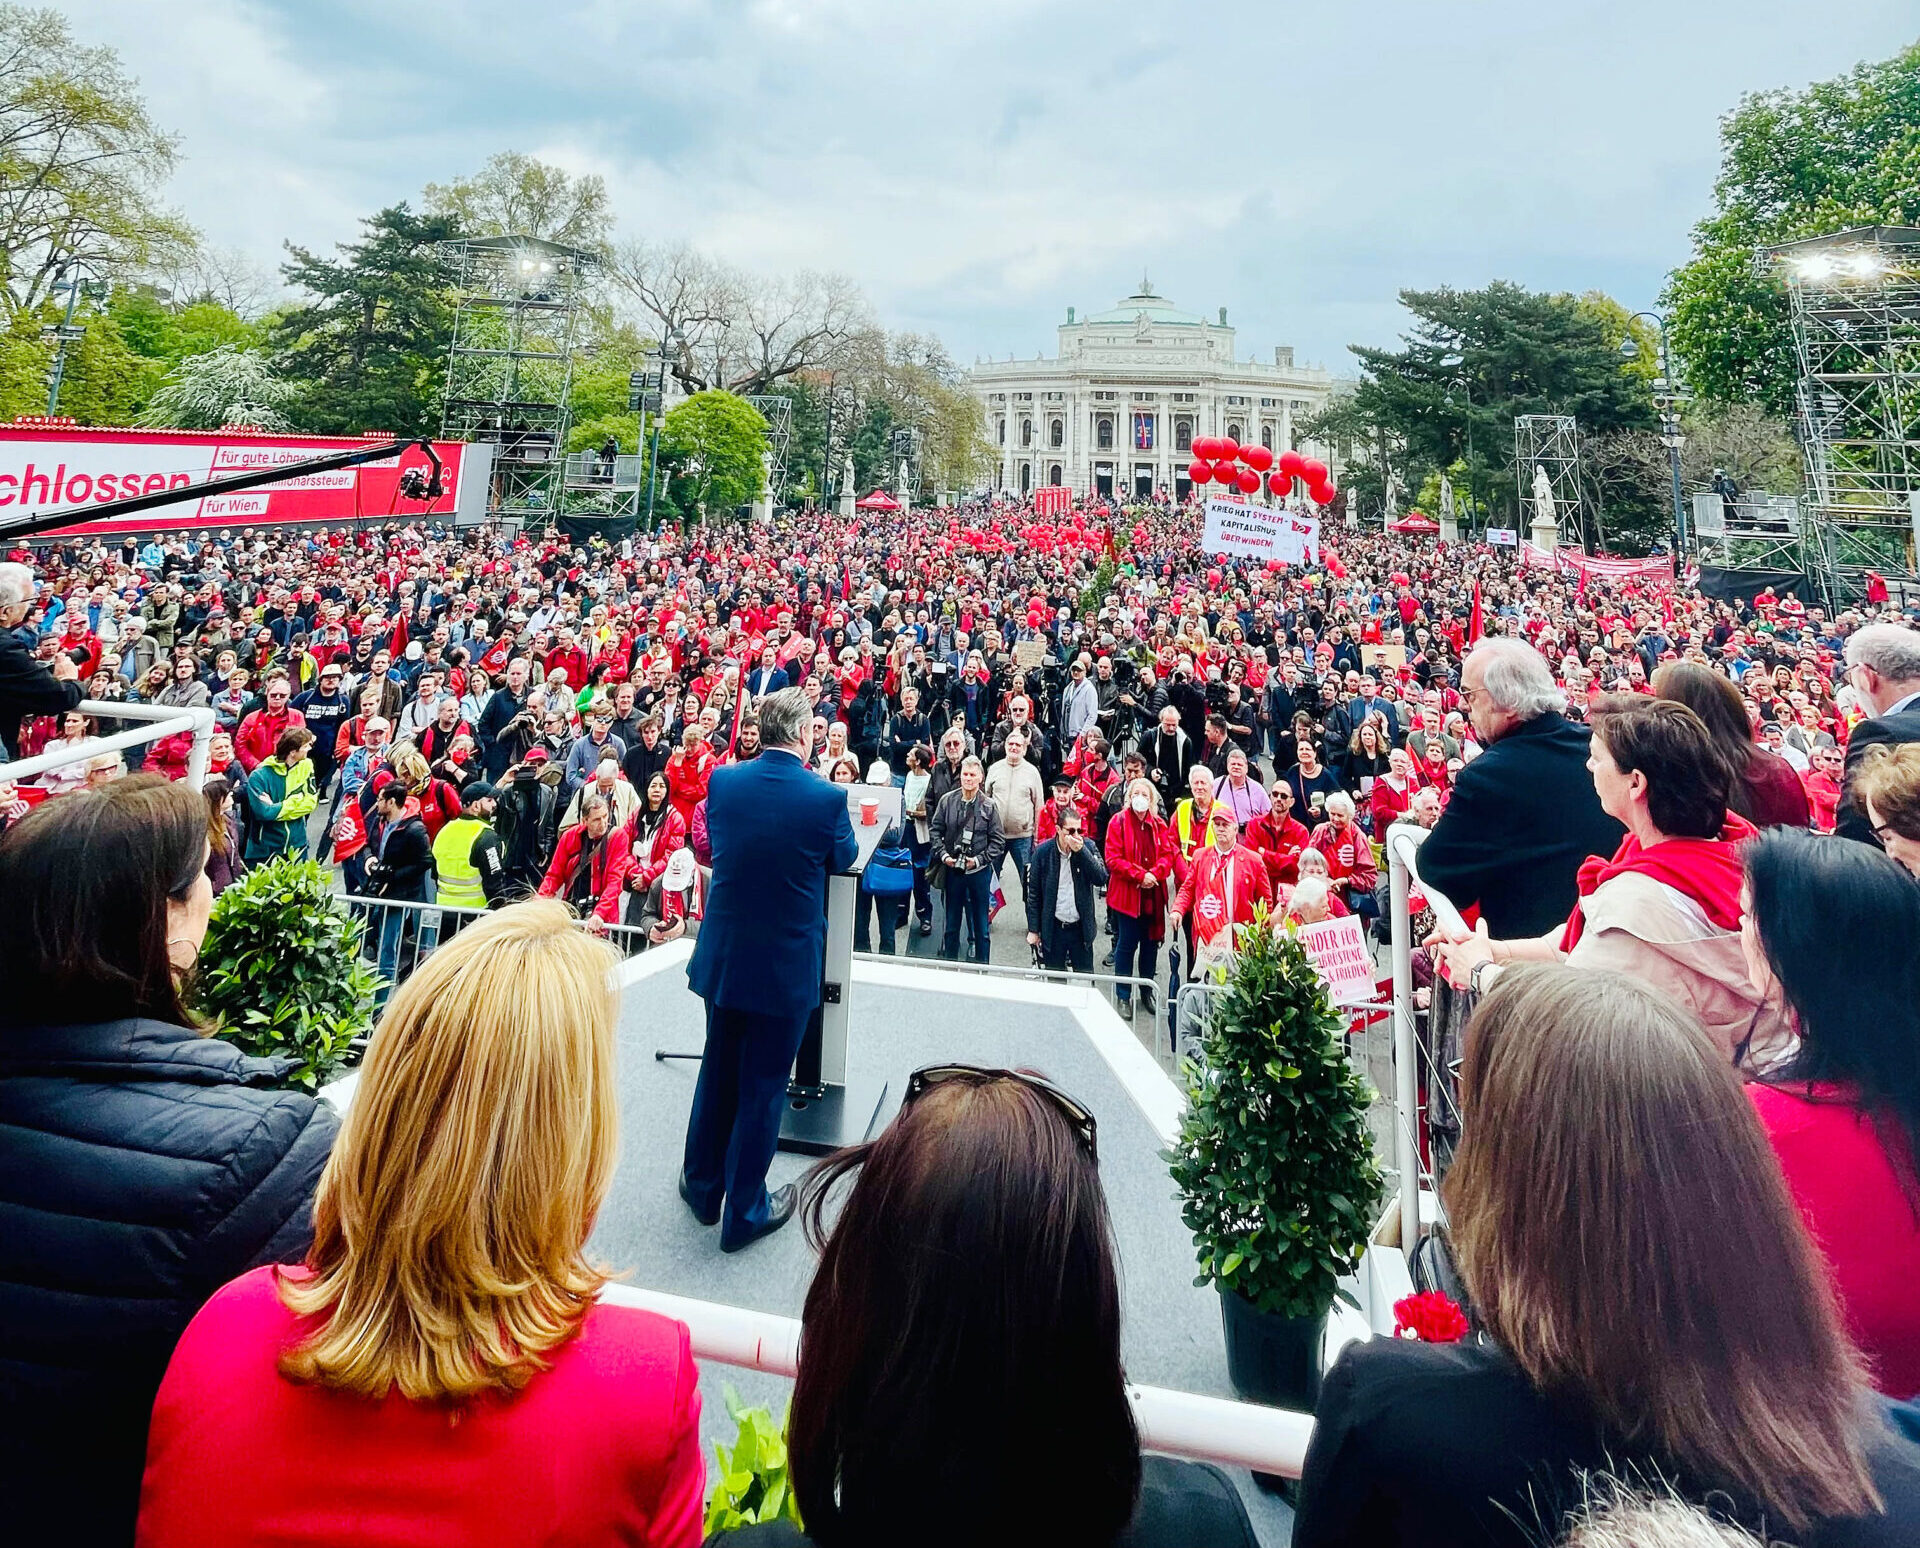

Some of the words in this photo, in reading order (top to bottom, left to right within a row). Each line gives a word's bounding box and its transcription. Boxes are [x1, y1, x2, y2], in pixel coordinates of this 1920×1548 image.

[221, 451, 239, 463] für
[242, 452, 269, 466] gute
[207, 499, 225, 513] für
[229, 499, 262, 512] Wien.
[1211, 505, 1234, 515] KRIEG
[1234, 509, 1252, 518] HAT
[1220, 520, 1277, 536] KAPITALISMUS
[1340, 927, 1360, 946] FÜR
[1328, 968, 1335, 983] &
[1335, 964, 1367, 982] FRIEDEN
